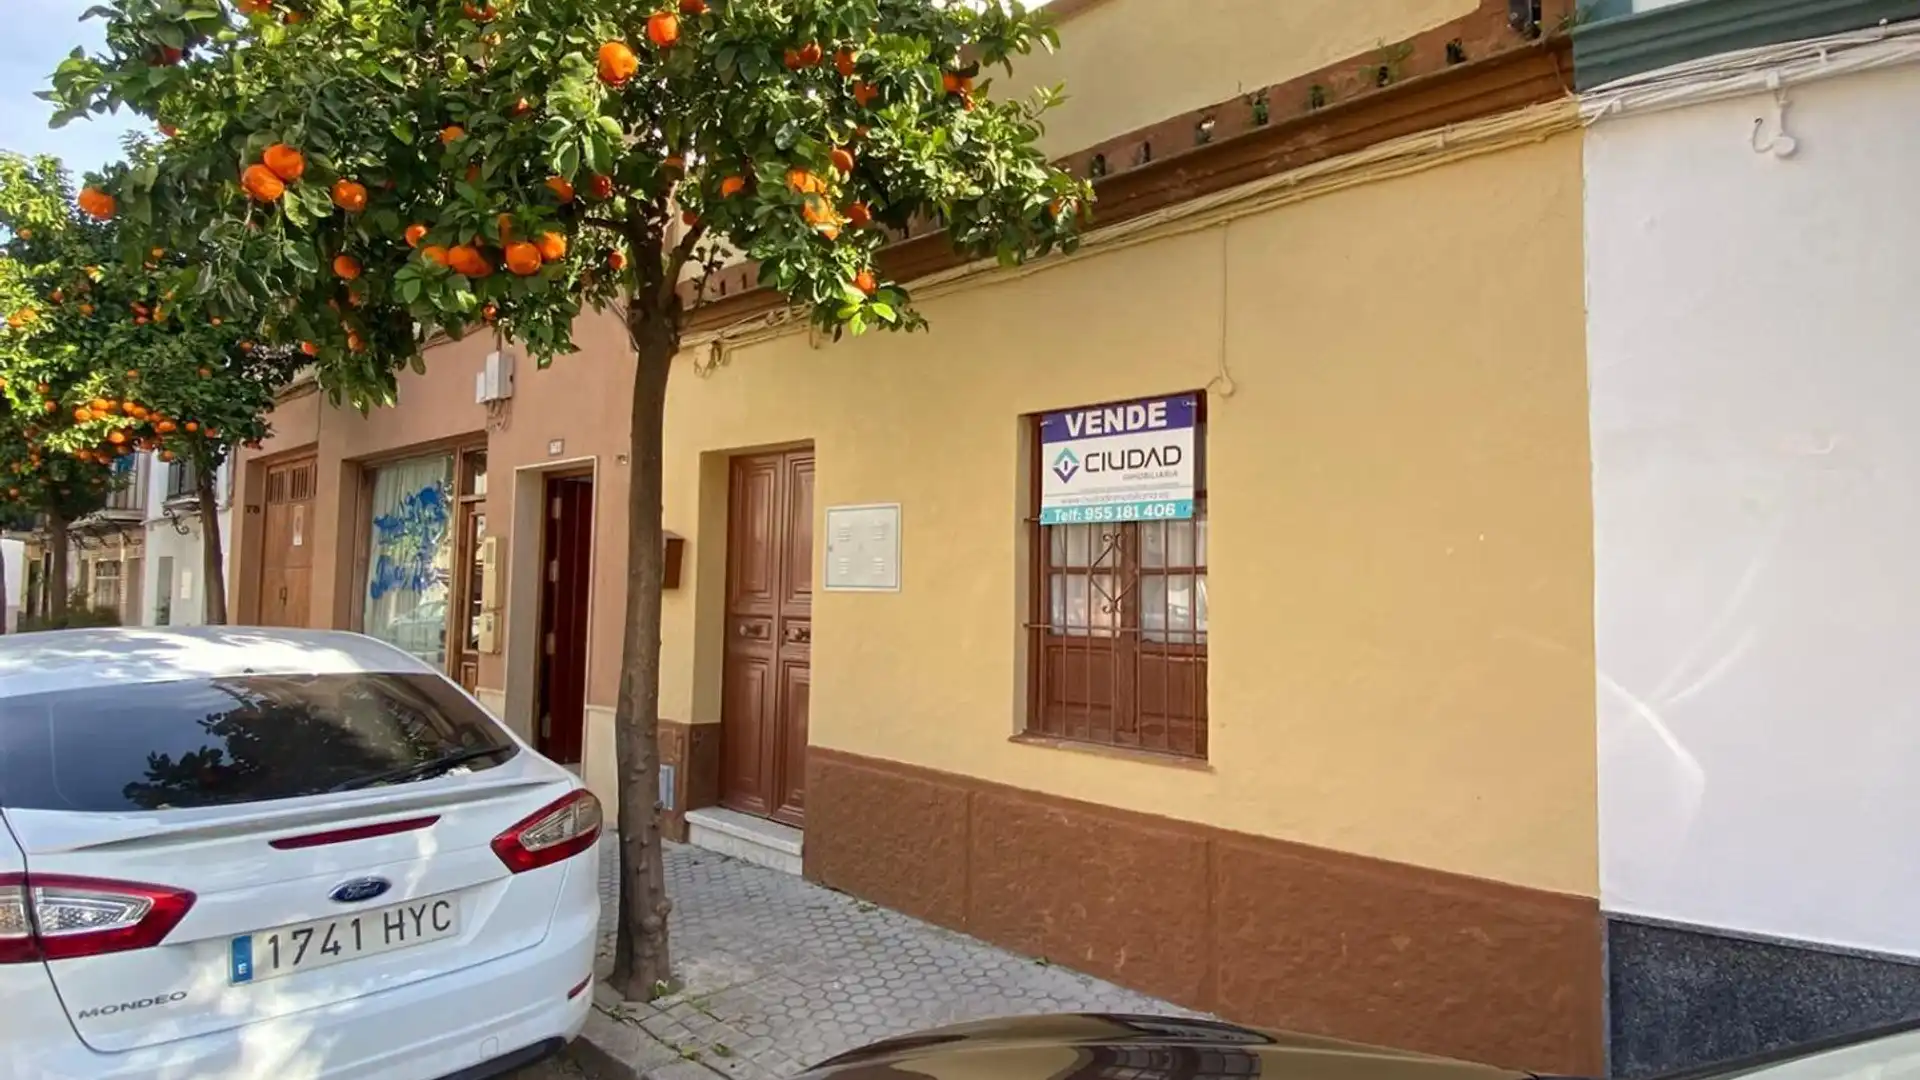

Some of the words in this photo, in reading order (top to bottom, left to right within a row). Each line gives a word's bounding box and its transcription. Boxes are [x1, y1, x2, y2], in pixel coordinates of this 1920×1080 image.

[1065, 402, 1168, 437] VENDE
[1085, 445, 1182, 472] CIUDAD
[1084, 506, 1113, 519] 955
[1116, 504, 1140, 518] 181
[1143, 502, 1176, 517] 406
[345, 883, 380, 899] Ford
[267, 917, 362, 969] 1741
[383, 900, 451, 944] HYC
[79, 991, 187, 1019] MONDEO
